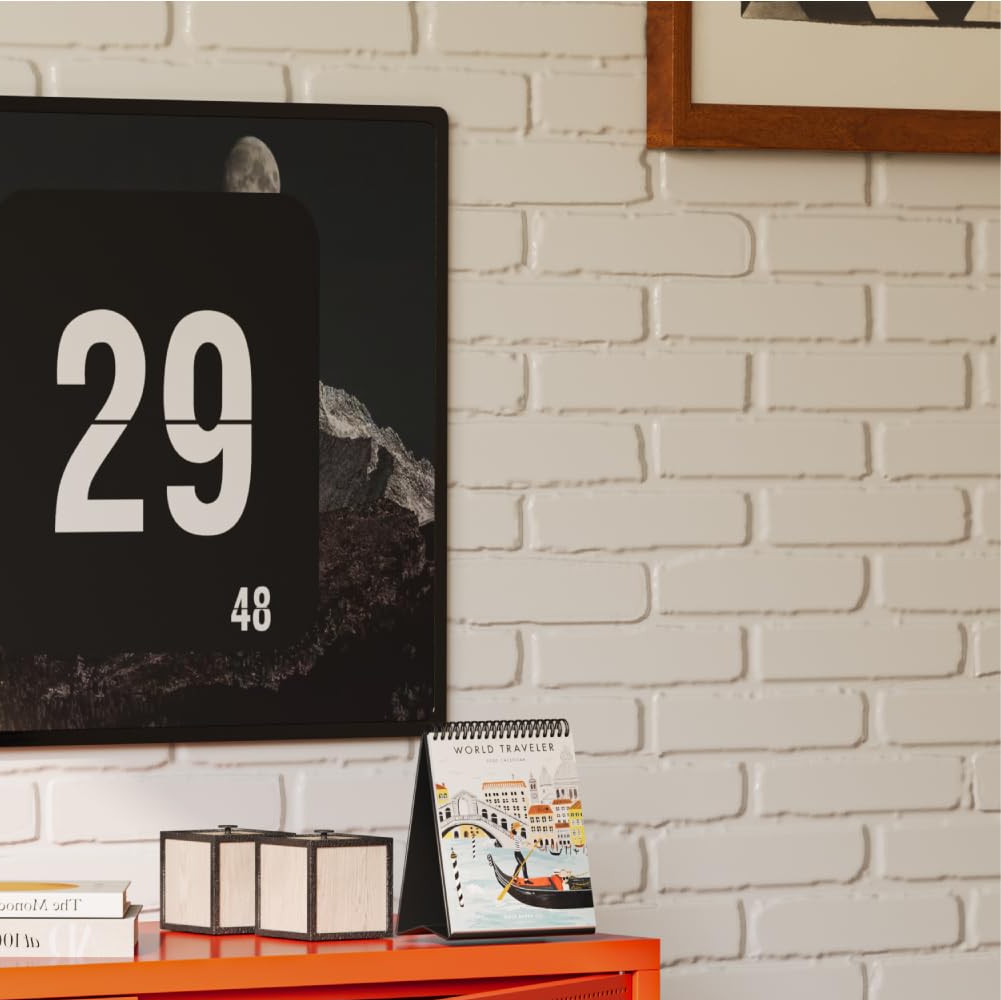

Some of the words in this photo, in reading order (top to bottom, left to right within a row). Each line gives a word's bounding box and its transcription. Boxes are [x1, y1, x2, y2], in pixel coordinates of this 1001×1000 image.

[54, 308, 253, 536] 29
[230, 585, 272, 632] 48
[453, 744, 494, 755] WORLD
[500, 742, 555, 753] TRAVELER
